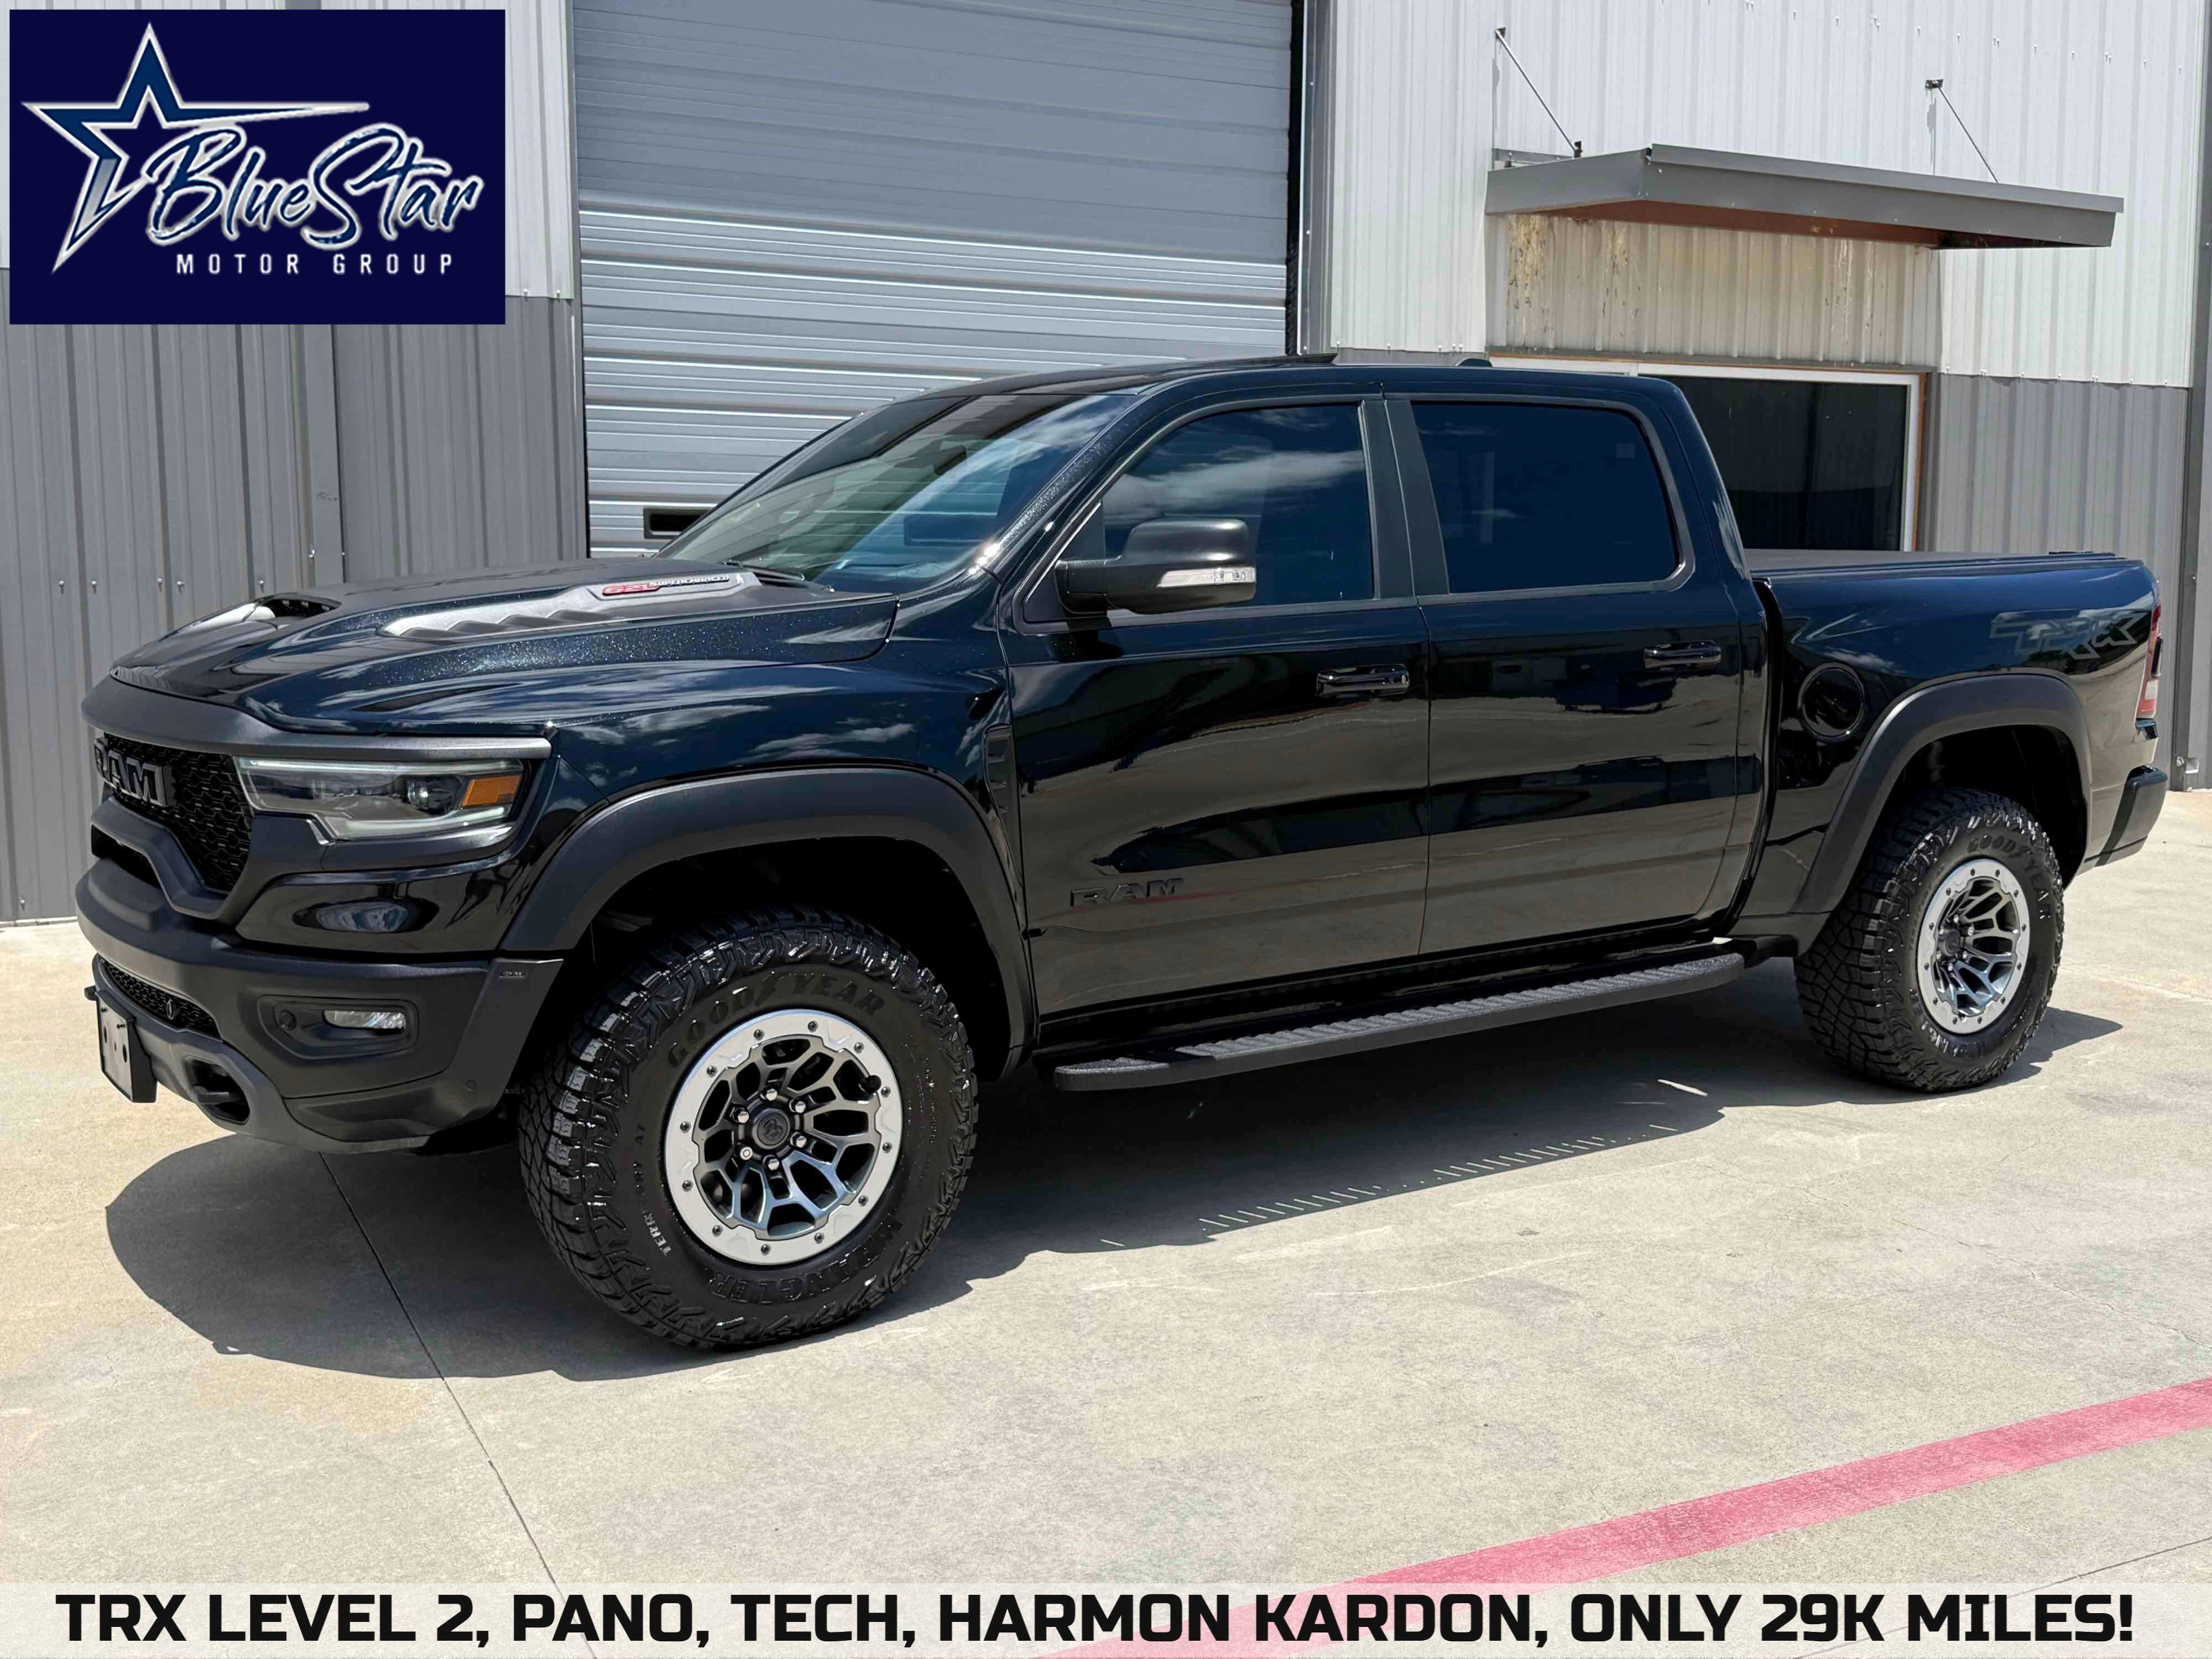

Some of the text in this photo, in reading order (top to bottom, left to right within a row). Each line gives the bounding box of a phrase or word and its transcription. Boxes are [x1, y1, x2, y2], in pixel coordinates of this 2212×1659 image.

[94, 737, 166, 807] RAM
[1070, 878, 1183, 907] RAM
[667, 972, 886, 1067] GOODYEAR
